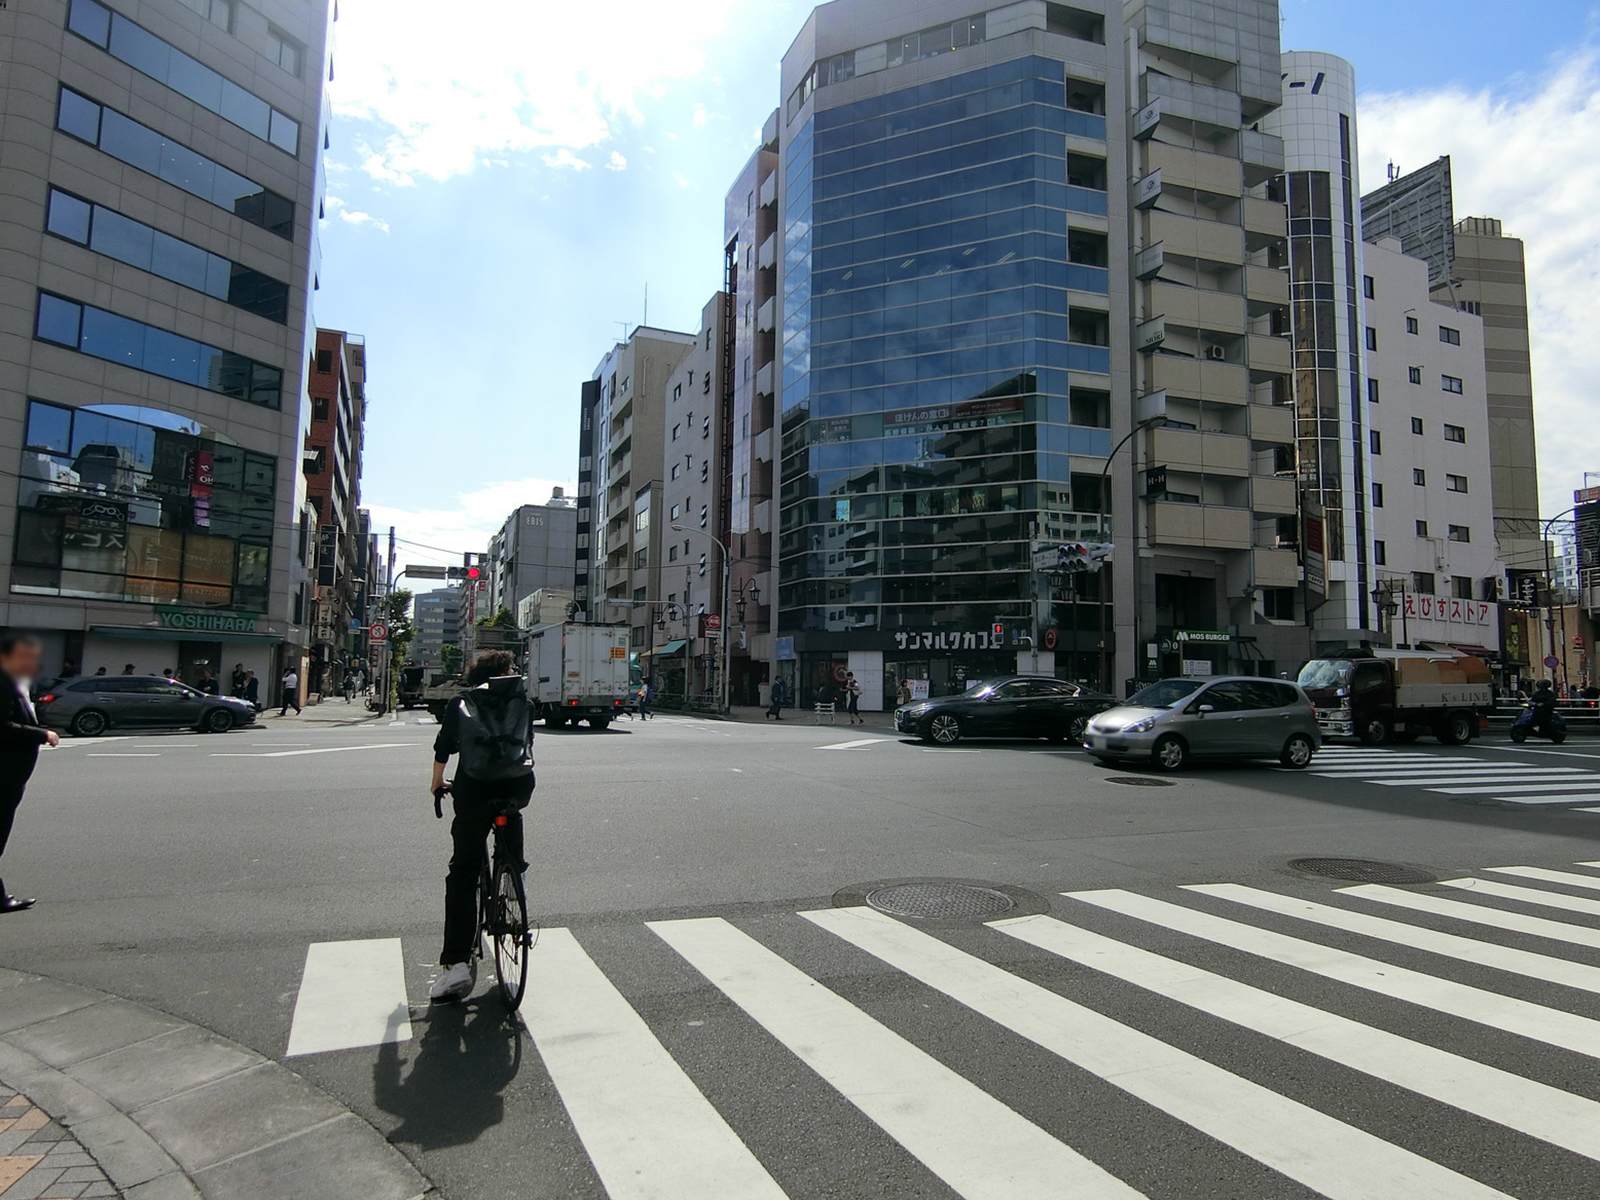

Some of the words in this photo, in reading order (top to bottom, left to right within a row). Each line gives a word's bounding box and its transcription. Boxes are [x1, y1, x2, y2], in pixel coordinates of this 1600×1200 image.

[894, 409, 946, 423] ほけんの窓口
[1405, 594, 1488, 621] えびすストア
[160, 612, 257, 631] YOSHIHARA
[1205, 633, 1230, 641] BURGER
[1461, 691, 1489, 702] LINE
